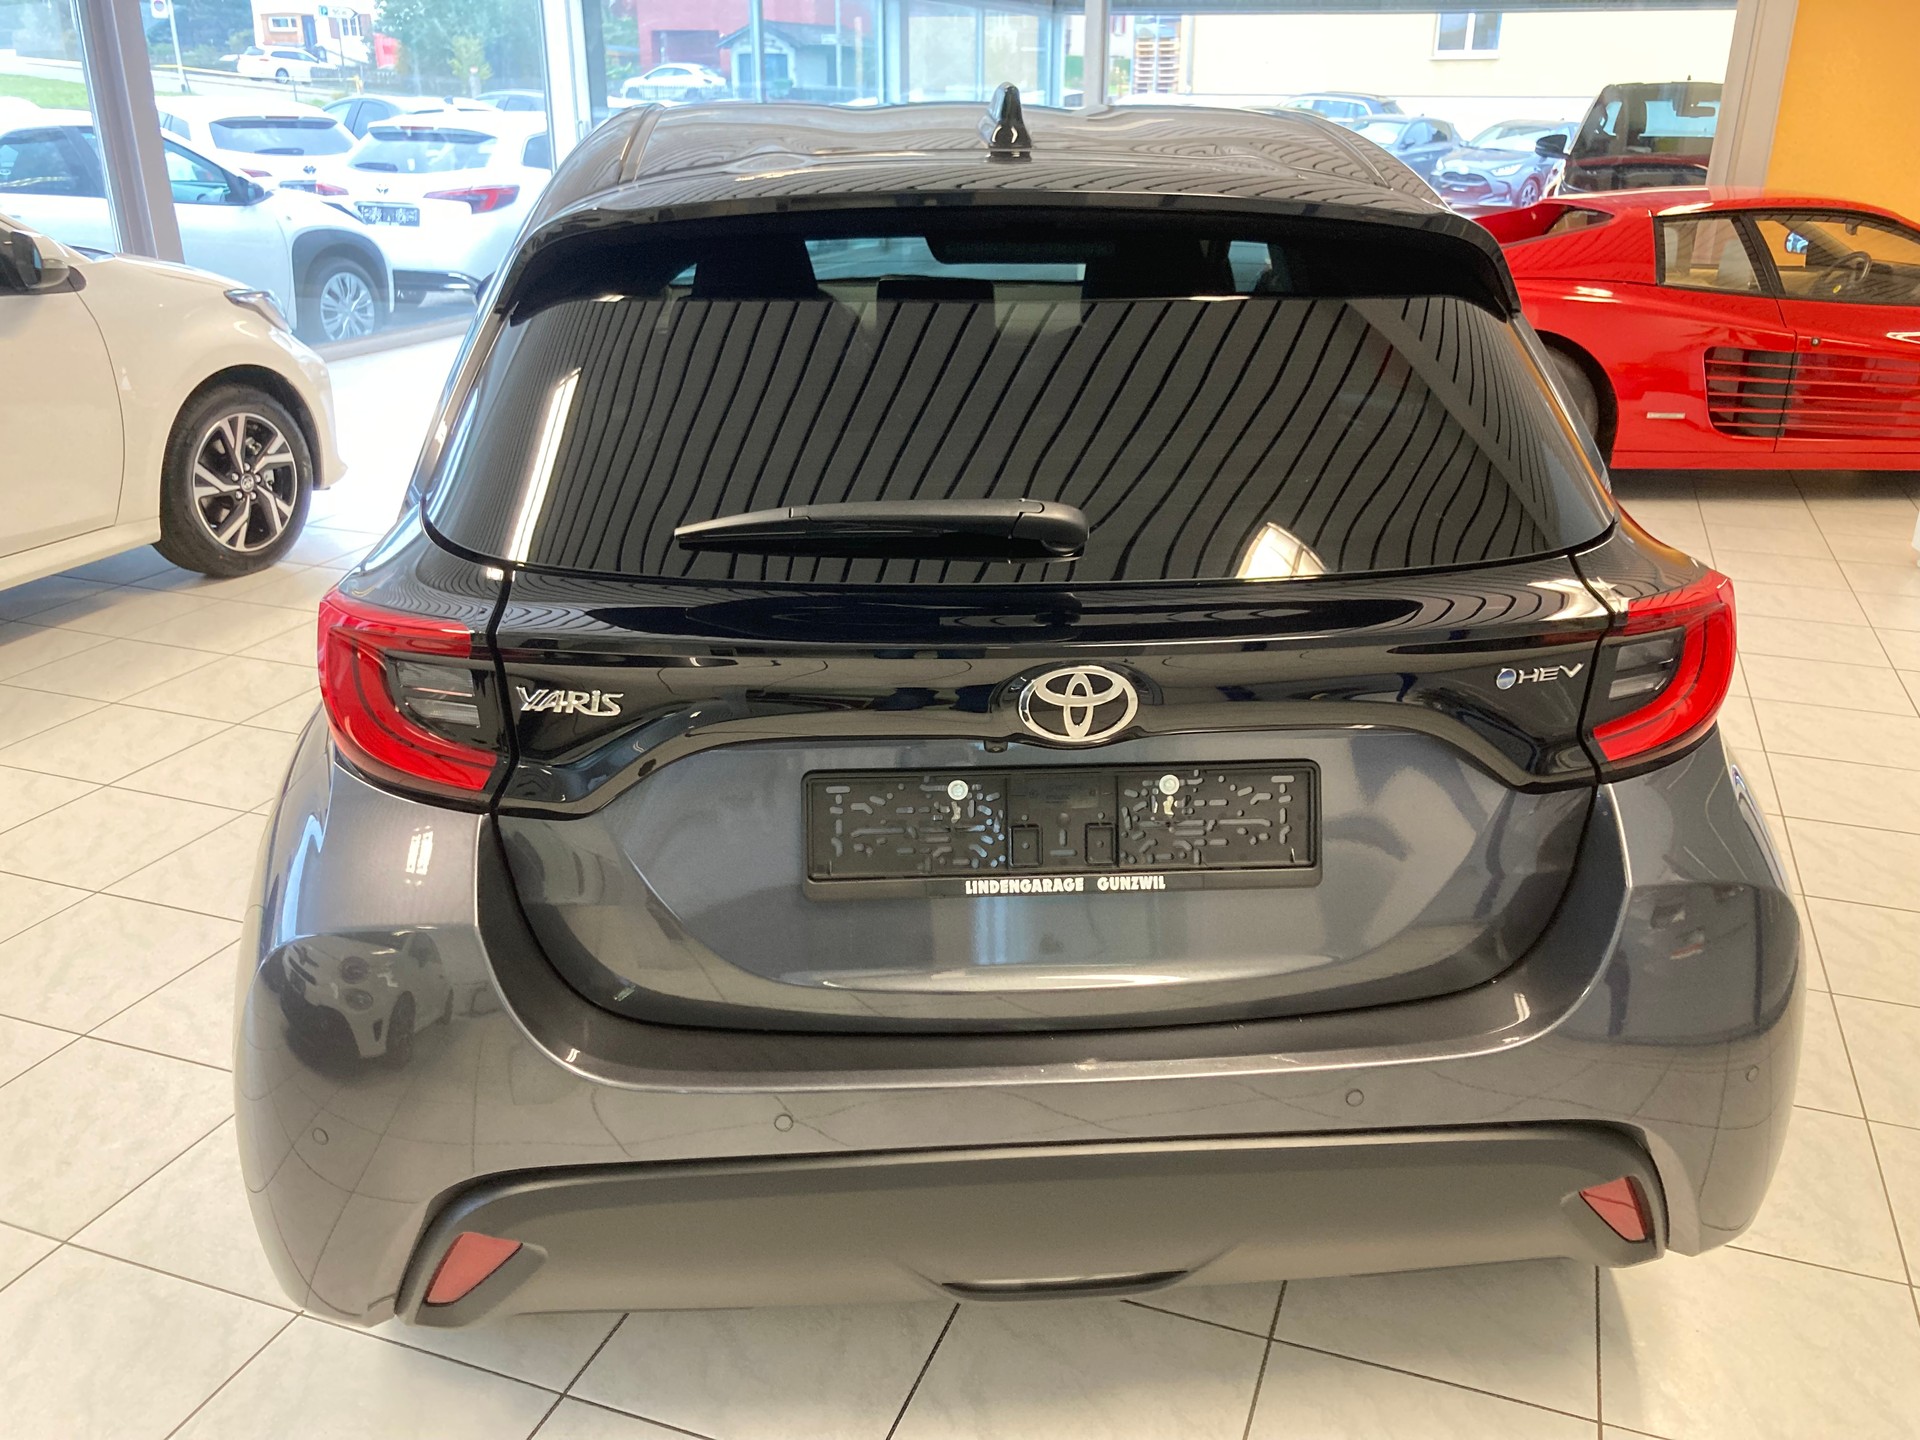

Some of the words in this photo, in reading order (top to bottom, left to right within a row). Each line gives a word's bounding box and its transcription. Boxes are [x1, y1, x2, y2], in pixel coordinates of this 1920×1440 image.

[1517, 663, 1584, 684] HEV
[516, 686, 623, 716] YARIS
[965, 877, 1084, 894] LINDENGARAGE
[1097, 876, 1165, 891] GUNZWIL
